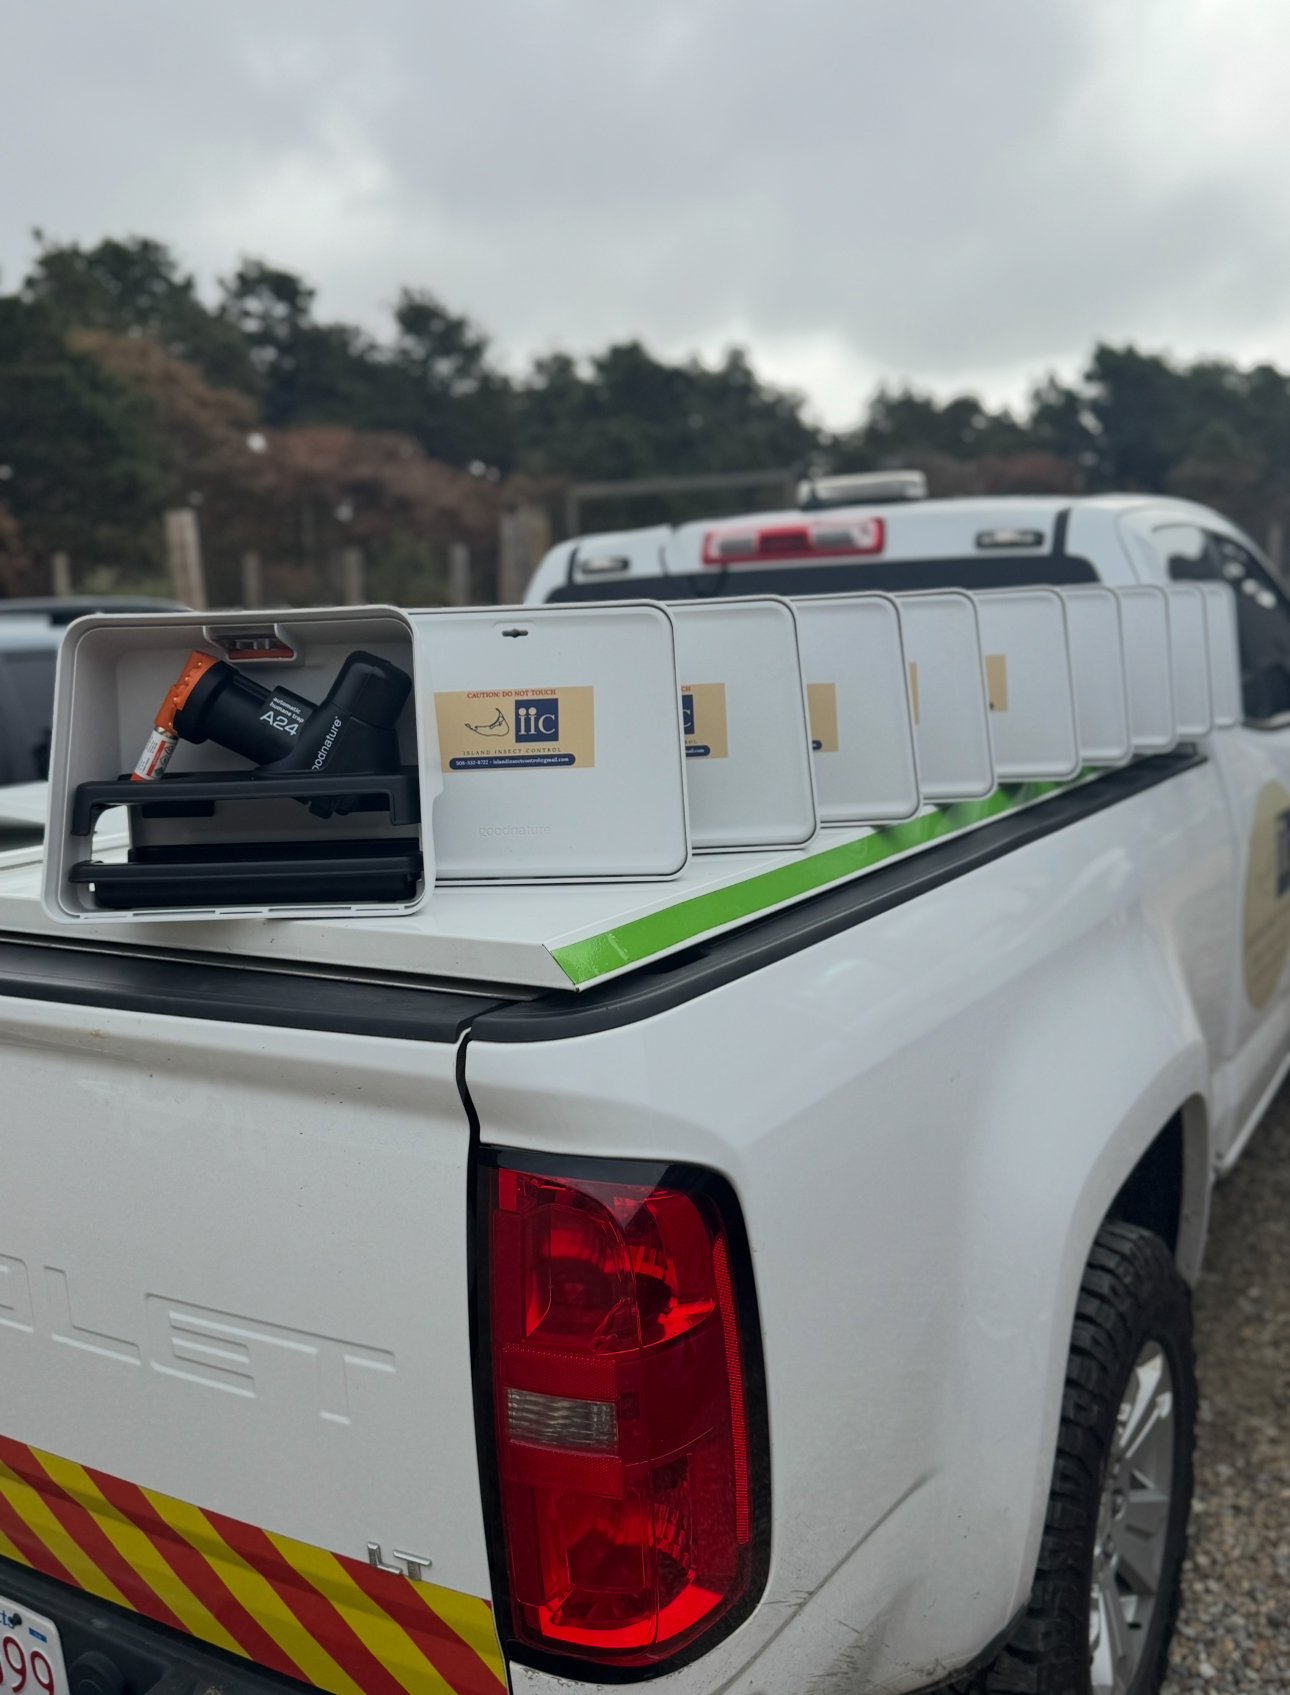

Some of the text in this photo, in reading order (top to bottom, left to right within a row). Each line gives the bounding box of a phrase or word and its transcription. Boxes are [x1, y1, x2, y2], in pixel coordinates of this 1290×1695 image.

[467, 690, 499, 699] CAUTION:
[514, 689, 530, 697] NOT
[531, 688, 556, 696] TOUCH
[269, 701, 304, 723] humane trap
[273, 697, 301, 714] automatic
[260, 711, 299, 736] A24
[312, 716, 342, 771] oodnature
[367, 1541, 432, 1581] LT
